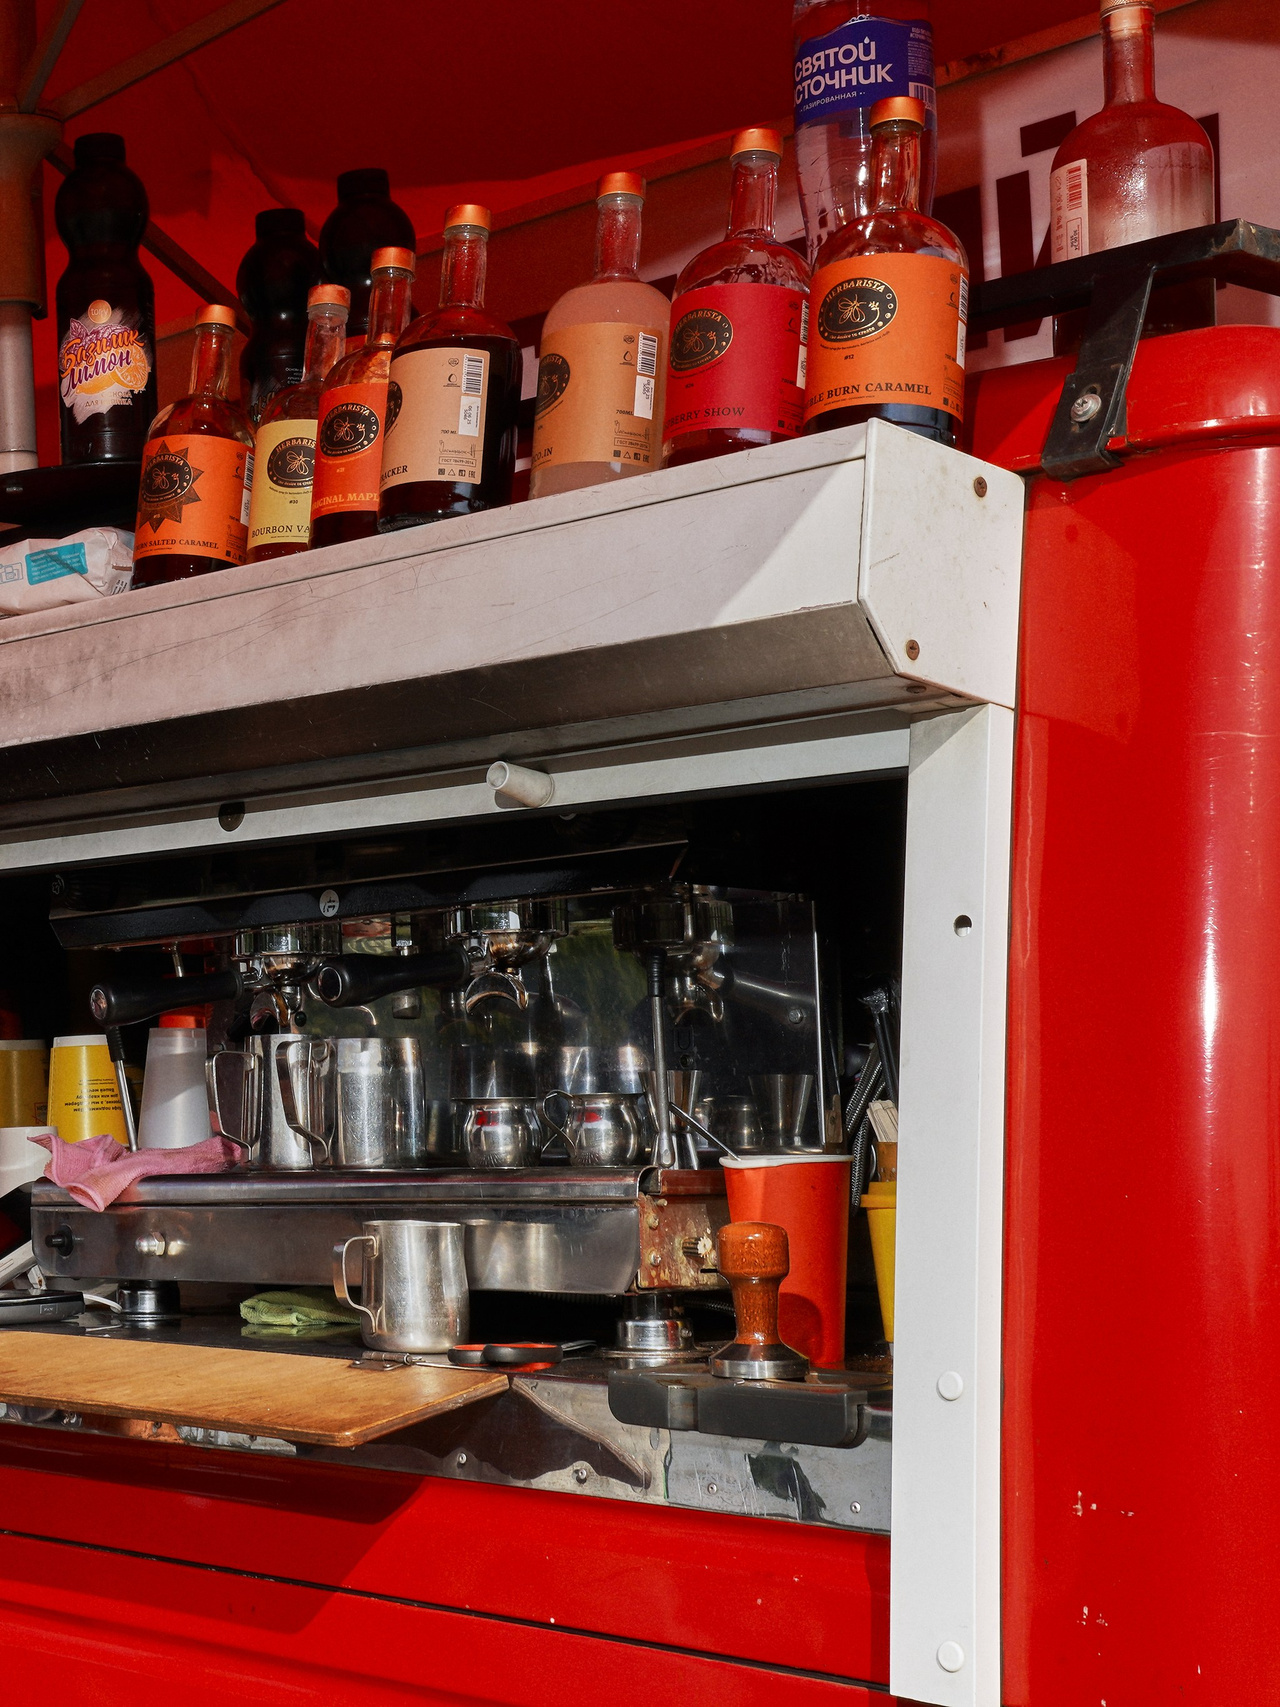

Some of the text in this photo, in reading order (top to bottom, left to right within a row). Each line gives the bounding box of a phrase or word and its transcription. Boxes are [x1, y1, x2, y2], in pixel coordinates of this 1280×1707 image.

[794, 37, 876, 82] СВЯТОЙ
[794, 63, 893, 107] СТОЧНИК
[826, 280, 885, 302] HERBARISTA
[675, 310, 722, 332] HERBARISTA
[827, 384, 860, 399] BURN
[865, 382, 932, 395] CARAMEL
[326, 404, 370, 423] HERBARISTA
[704, 407, 745, 418] SHOW
[251, 525, 293, 538] BOURBON
[149, 538, 177, 547] SALTED
[179, 539, 219, 549] CARAMEL
